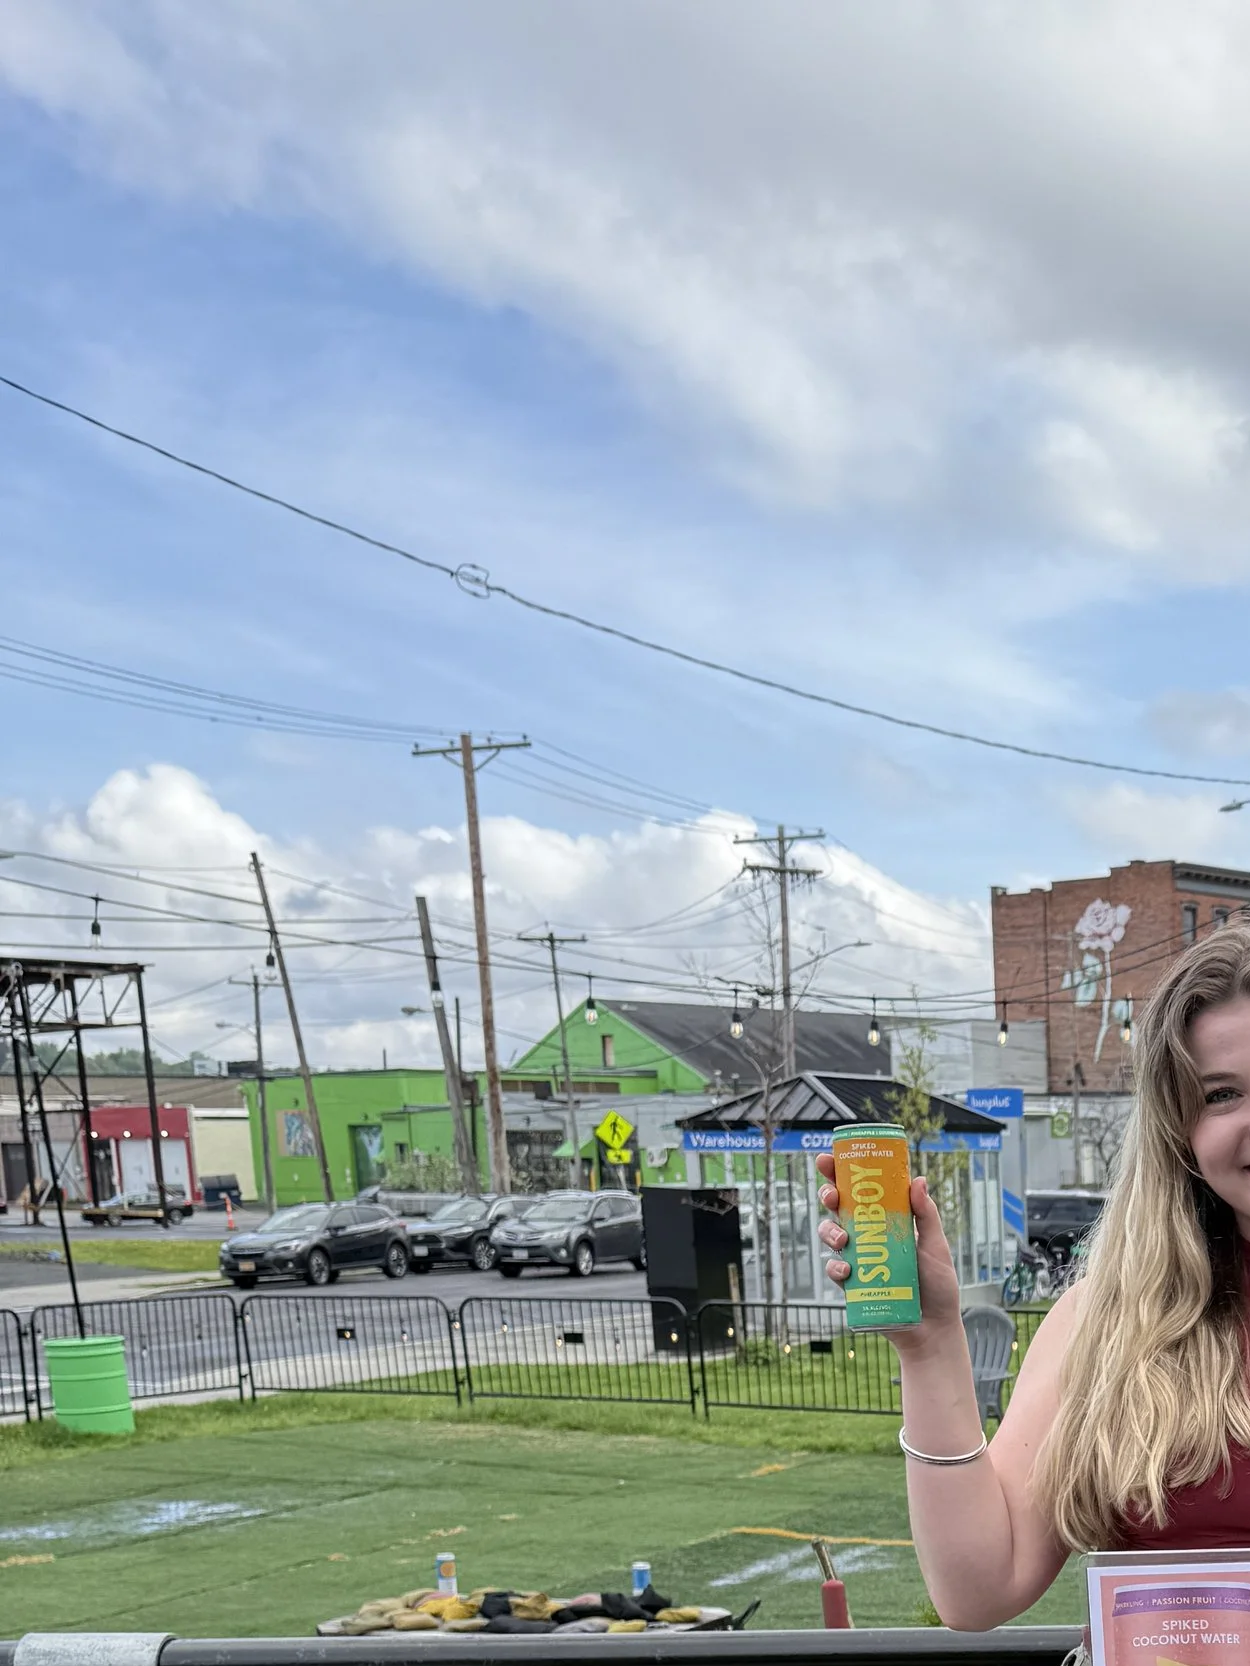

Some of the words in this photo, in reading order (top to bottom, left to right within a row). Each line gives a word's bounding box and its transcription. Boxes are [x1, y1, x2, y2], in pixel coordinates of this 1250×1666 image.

[690, 1132, 766, 1148] Warehouse
[840, 1150, 870, 1160] COCONUT
[849, 1163, 891, 1283] SUNBOY
[1152, 1597, 1190, 1606] PASSION
[1192, 1596, 1216, 1604] FRUIT
[1162, 1620, 1209, 1630] SPIKED
[1132, 1634, 1197, 1647] COCONUT
[1200, 1634, 1240, 1644] WATER
